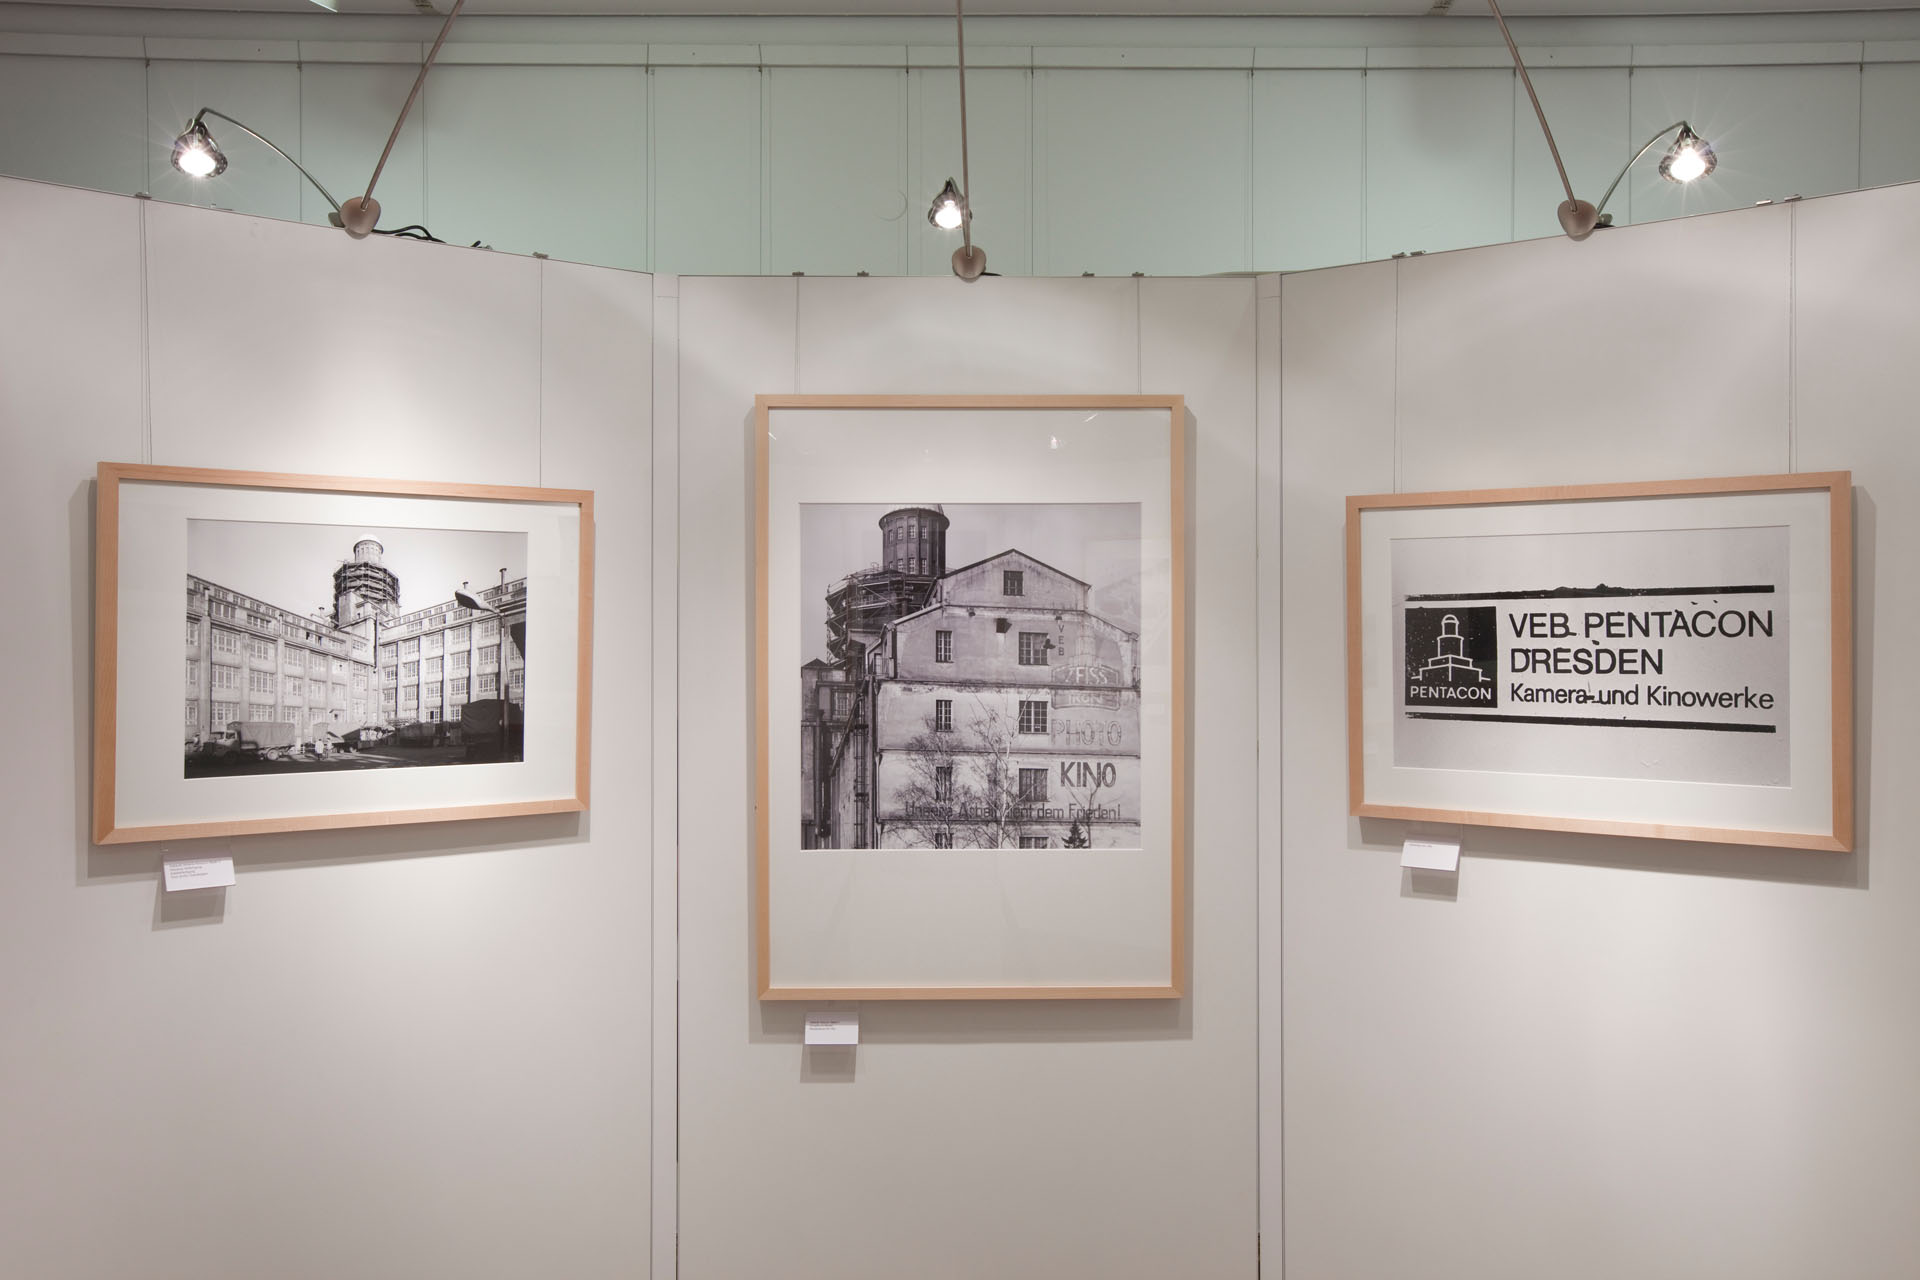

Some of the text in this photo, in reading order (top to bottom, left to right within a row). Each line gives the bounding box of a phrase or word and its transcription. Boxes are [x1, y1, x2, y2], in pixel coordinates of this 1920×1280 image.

[1509, 610, 1773, 638] VEB PENTACON
[1511, 648, 1663, 675] DRESDEN
[1410, 685, 1492, 700] PENTACON
[1647, 685, 1774, 709] Kinowerke
[1061, 761, 1116, 788] KINO
[1037, 802, 1065, 819] dem
